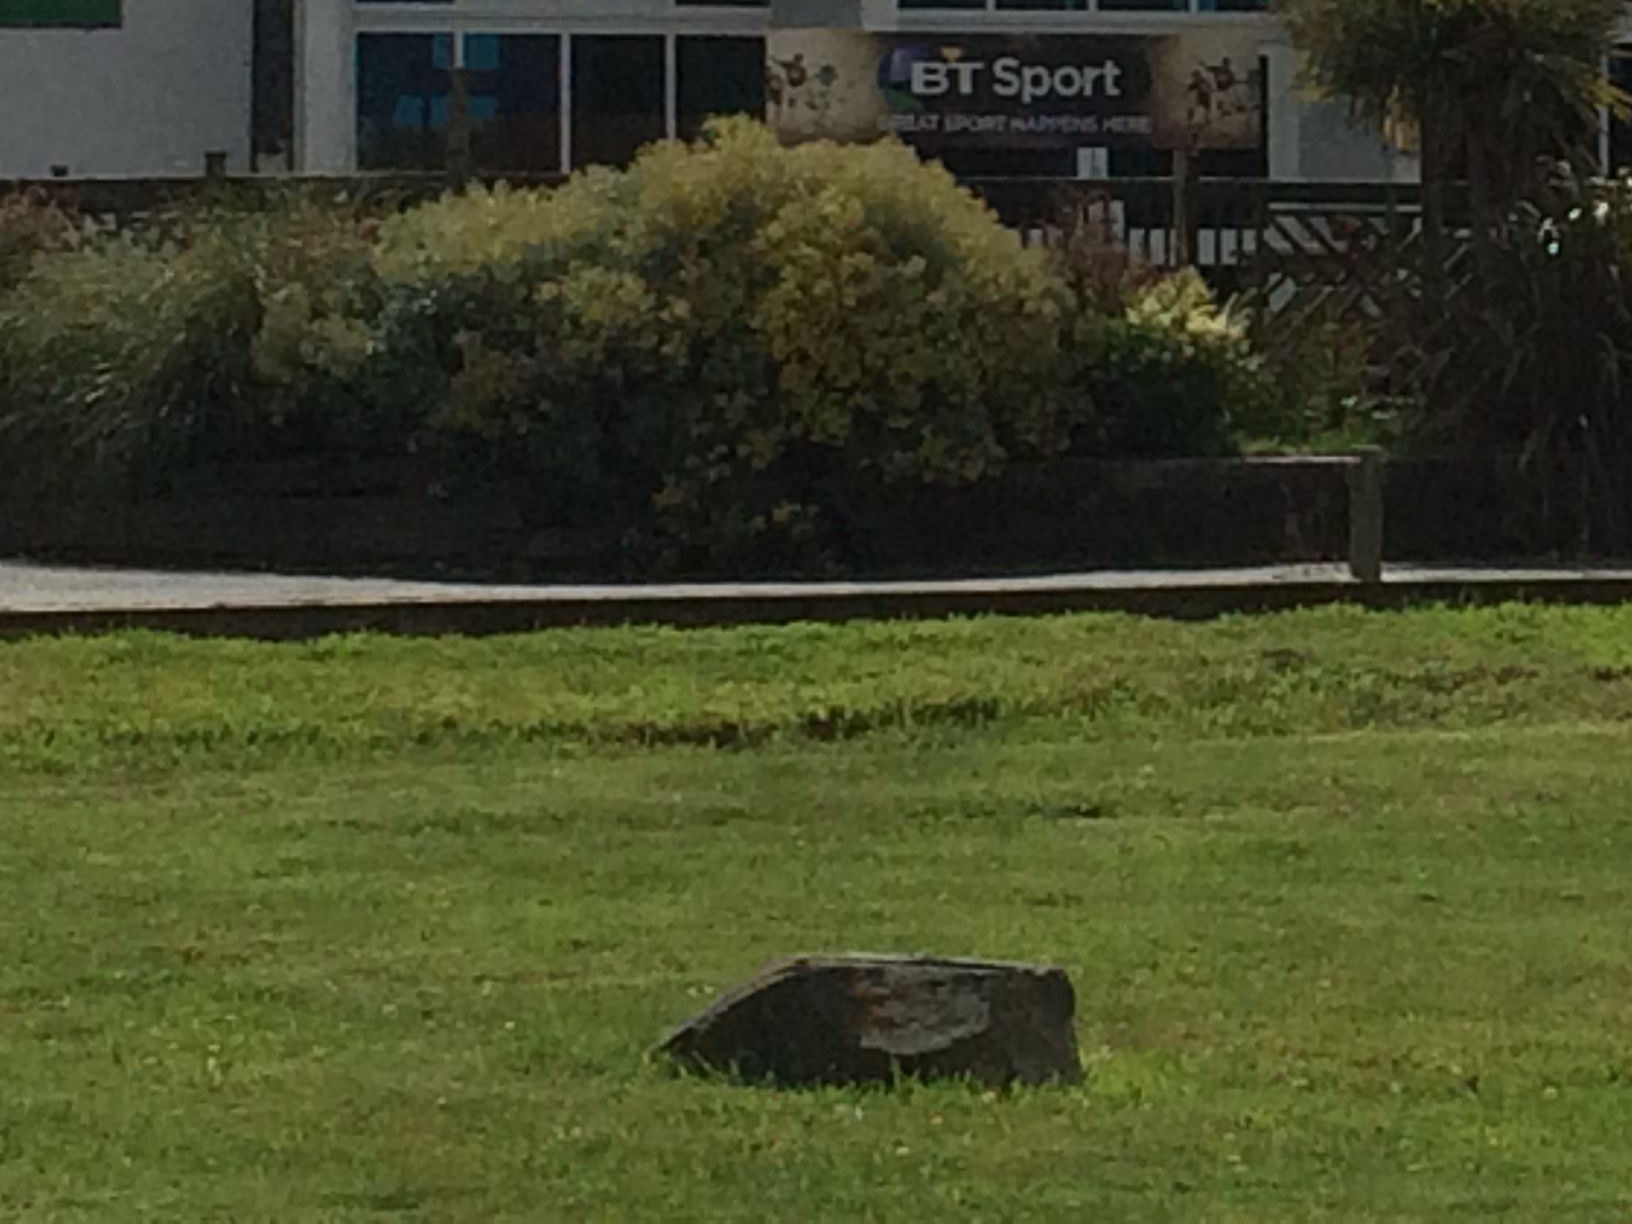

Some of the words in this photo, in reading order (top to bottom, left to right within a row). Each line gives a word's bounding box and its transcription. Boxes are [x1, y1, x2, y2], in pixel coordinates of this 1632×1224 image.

[910, 60, 985, 95] BT
[991, 56, 1123, 105] Sport
[1102, 115, 1153, 134] HERE
